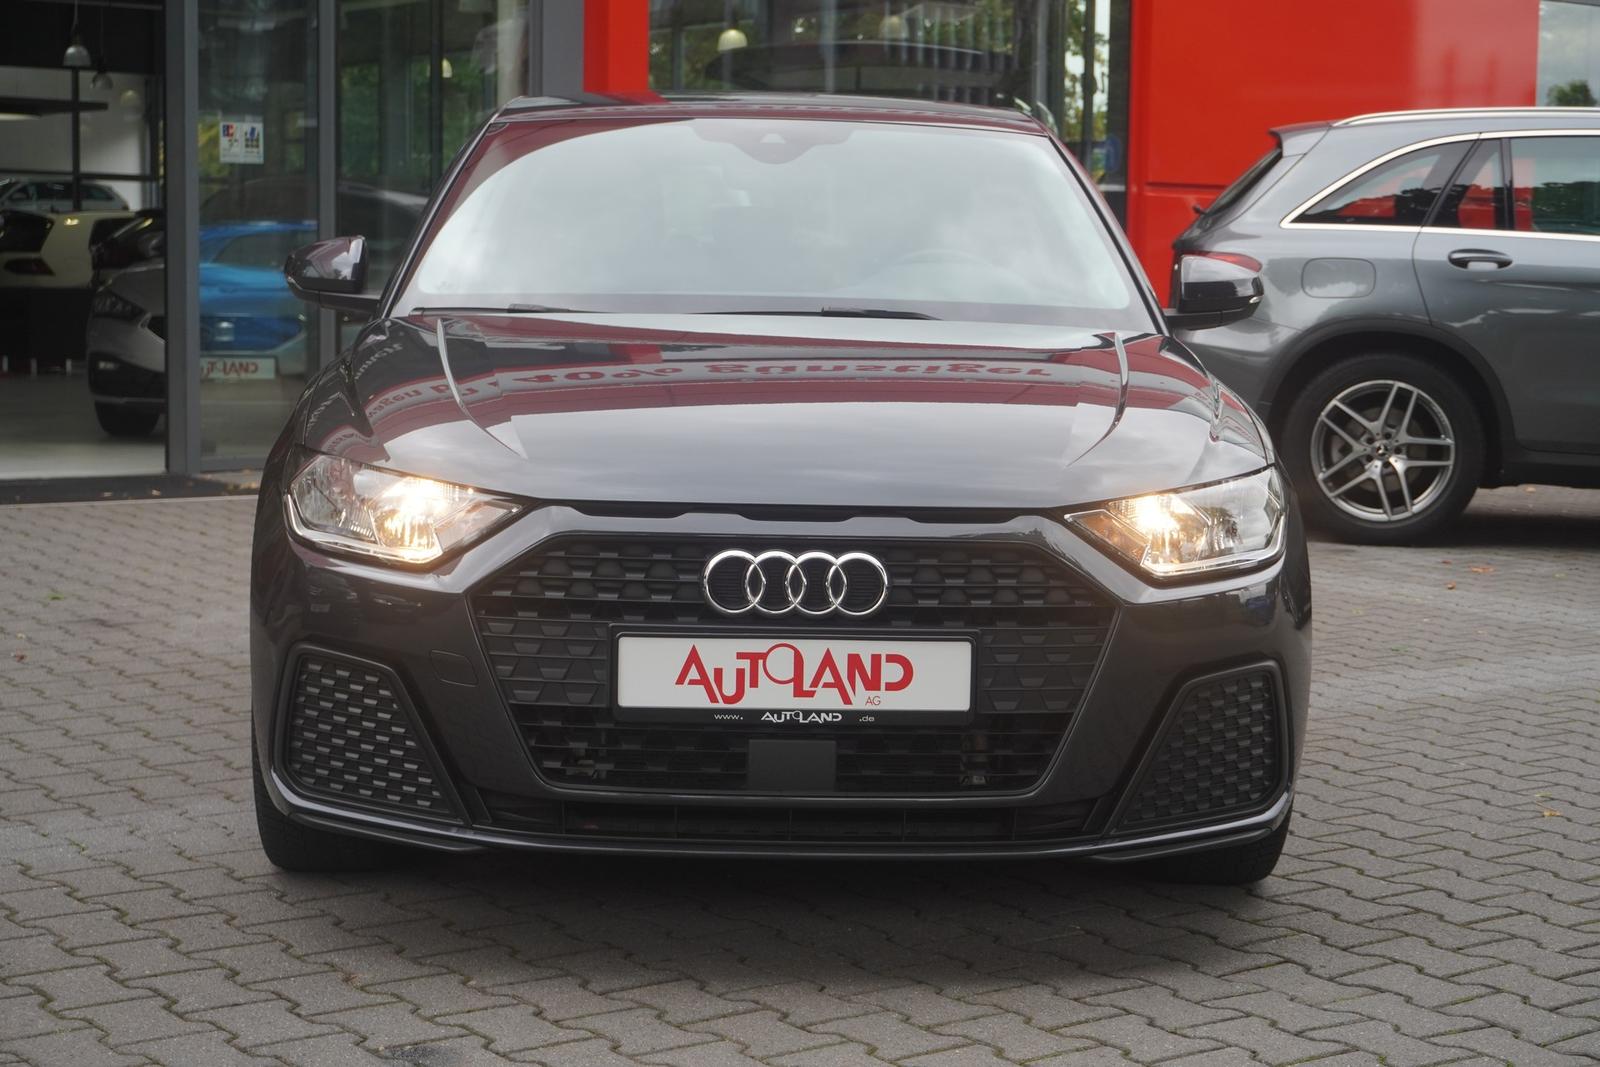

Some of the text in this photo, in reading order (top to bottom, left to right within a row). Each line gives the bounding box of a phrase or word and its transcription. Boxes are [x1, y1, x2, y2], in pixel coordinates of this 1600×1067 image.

[674, 642, 914, 706] AUTOLAND
[864, 695, 882, 707] AG
[760, 710, 843, 724] AUTOLAND
[858, 715, 876, 723] .de
